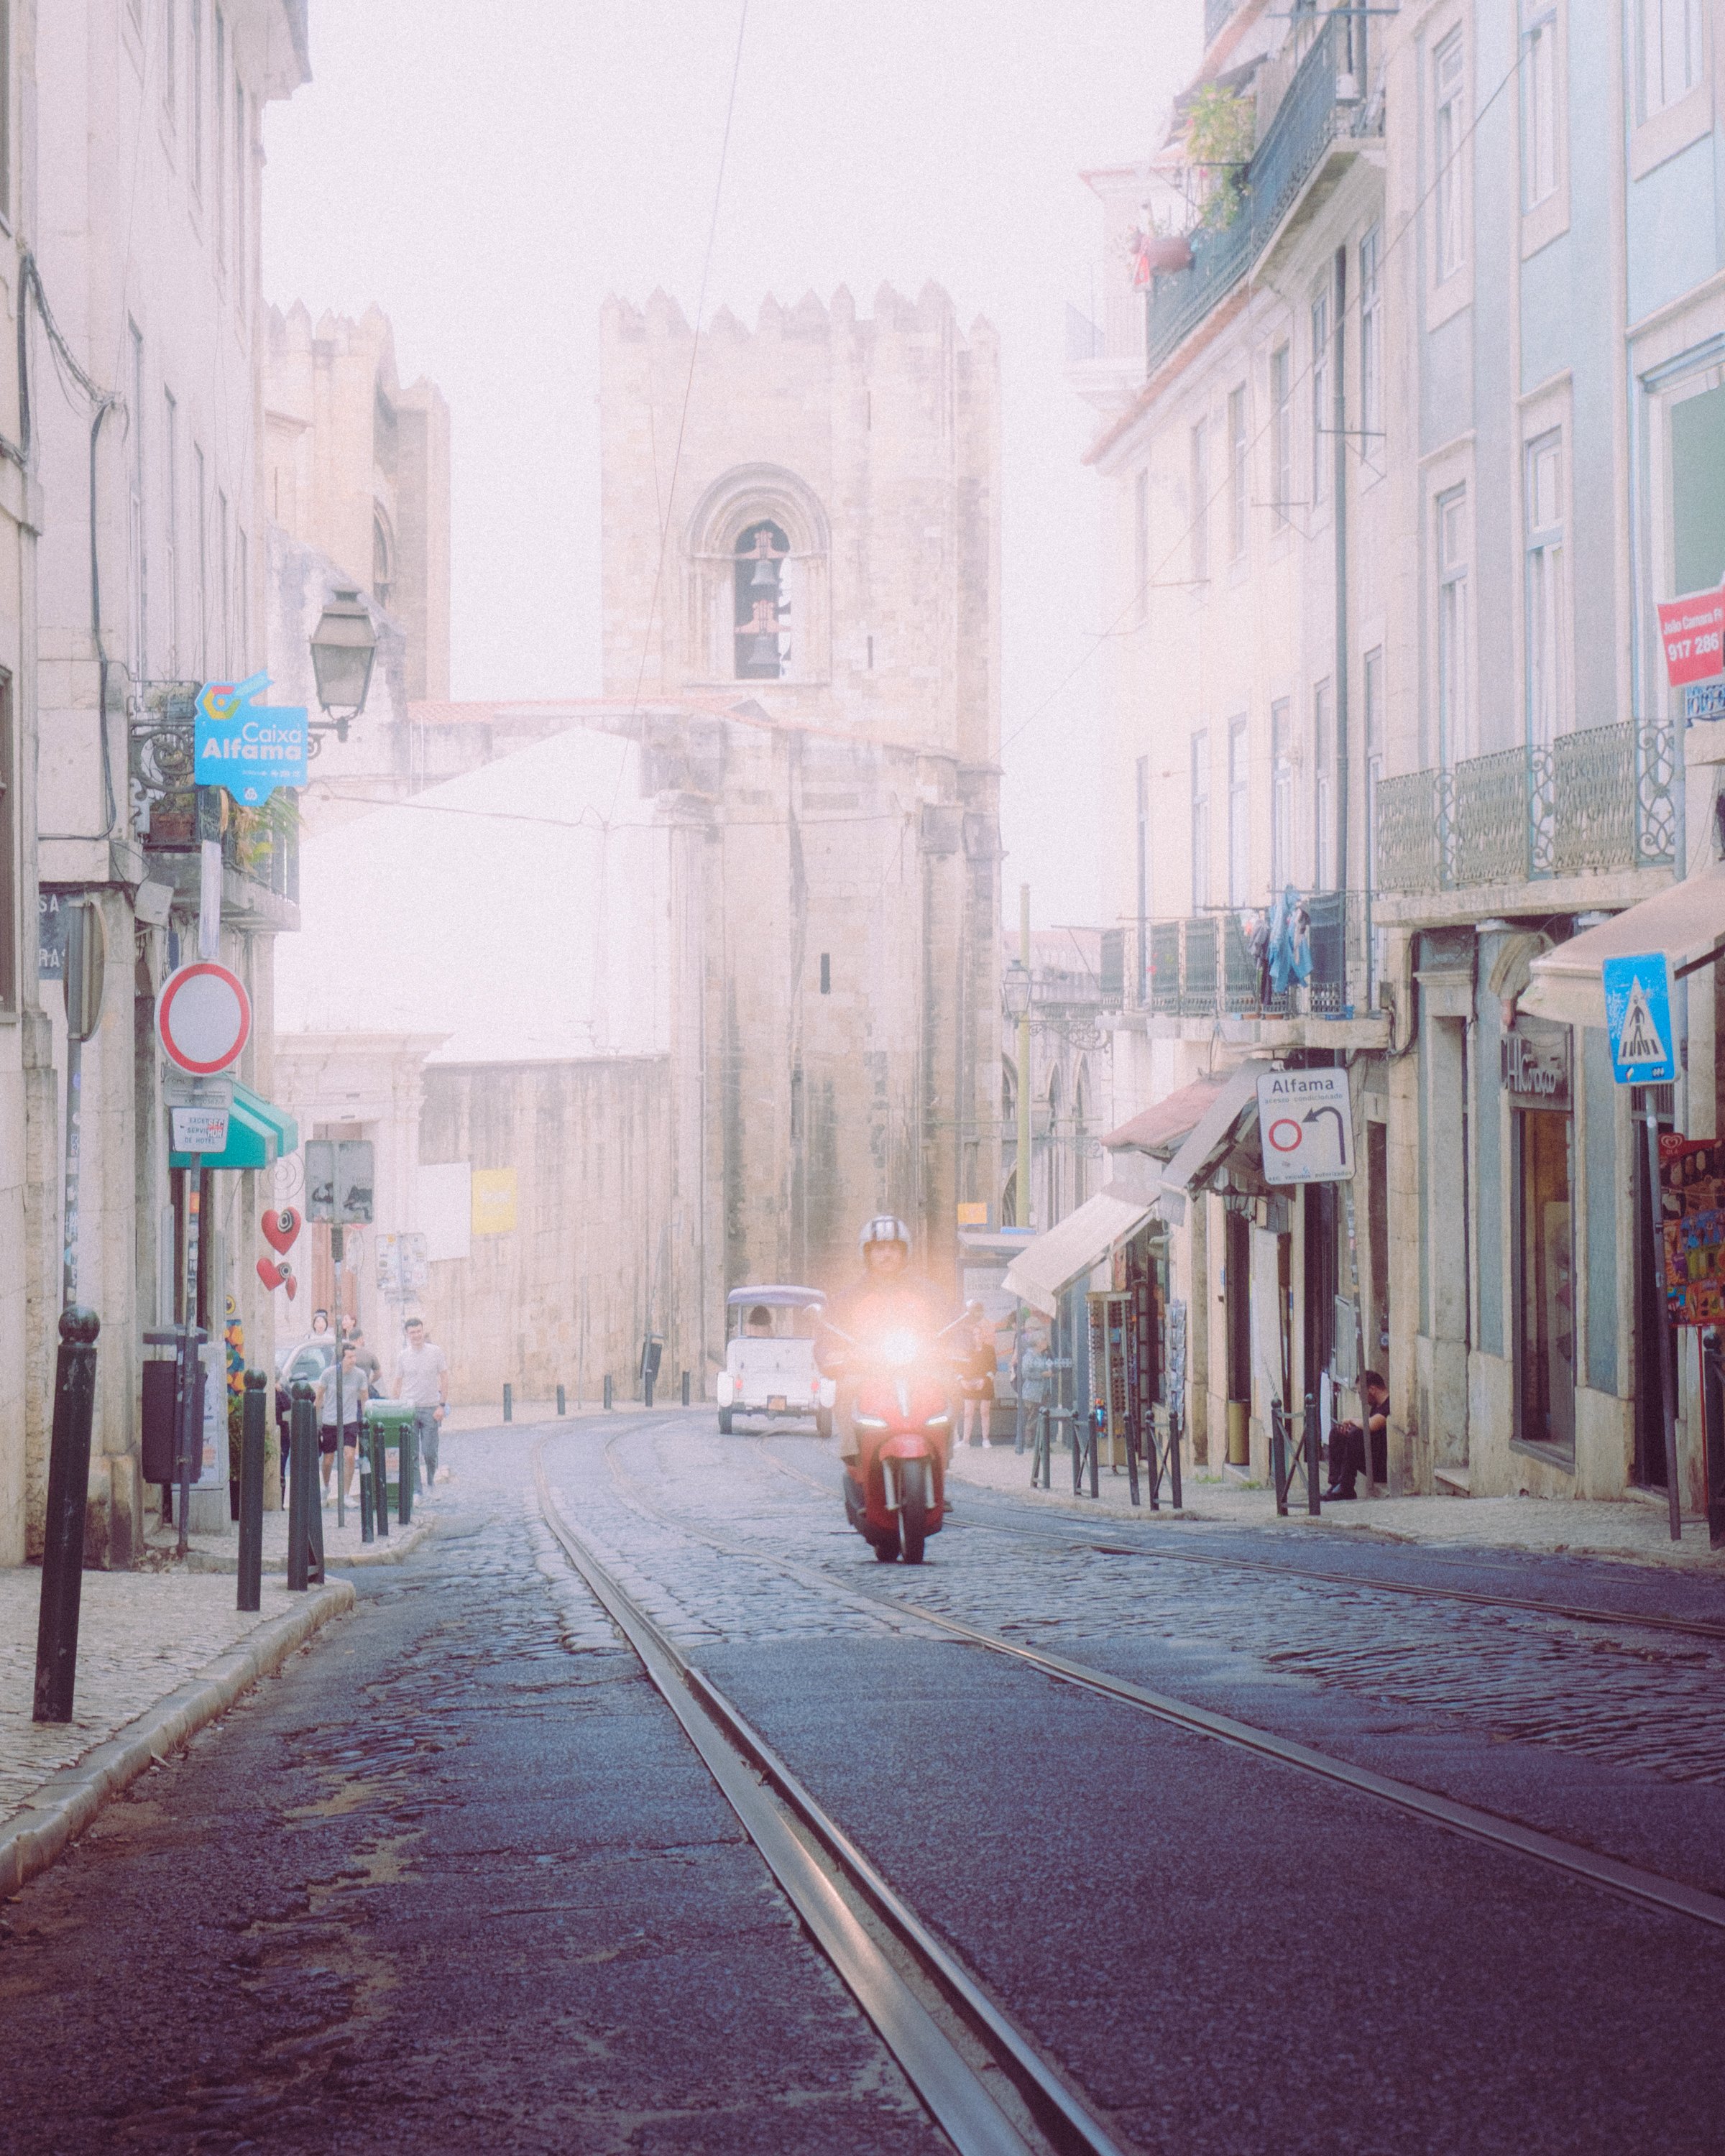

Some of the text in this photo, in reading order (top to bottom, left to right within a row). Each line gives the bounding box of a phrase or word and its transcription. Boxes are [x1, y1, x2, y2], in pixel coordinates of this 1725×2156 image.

[1668, 632, 1720, 662] 917 286
[242, 721, 303, 744] Caixa
[201, 737, 303, 760] Alfama
[1271, 1079, 1335, 1094] Alfama
[1294, 1093, 1343, 1102] condicionado
